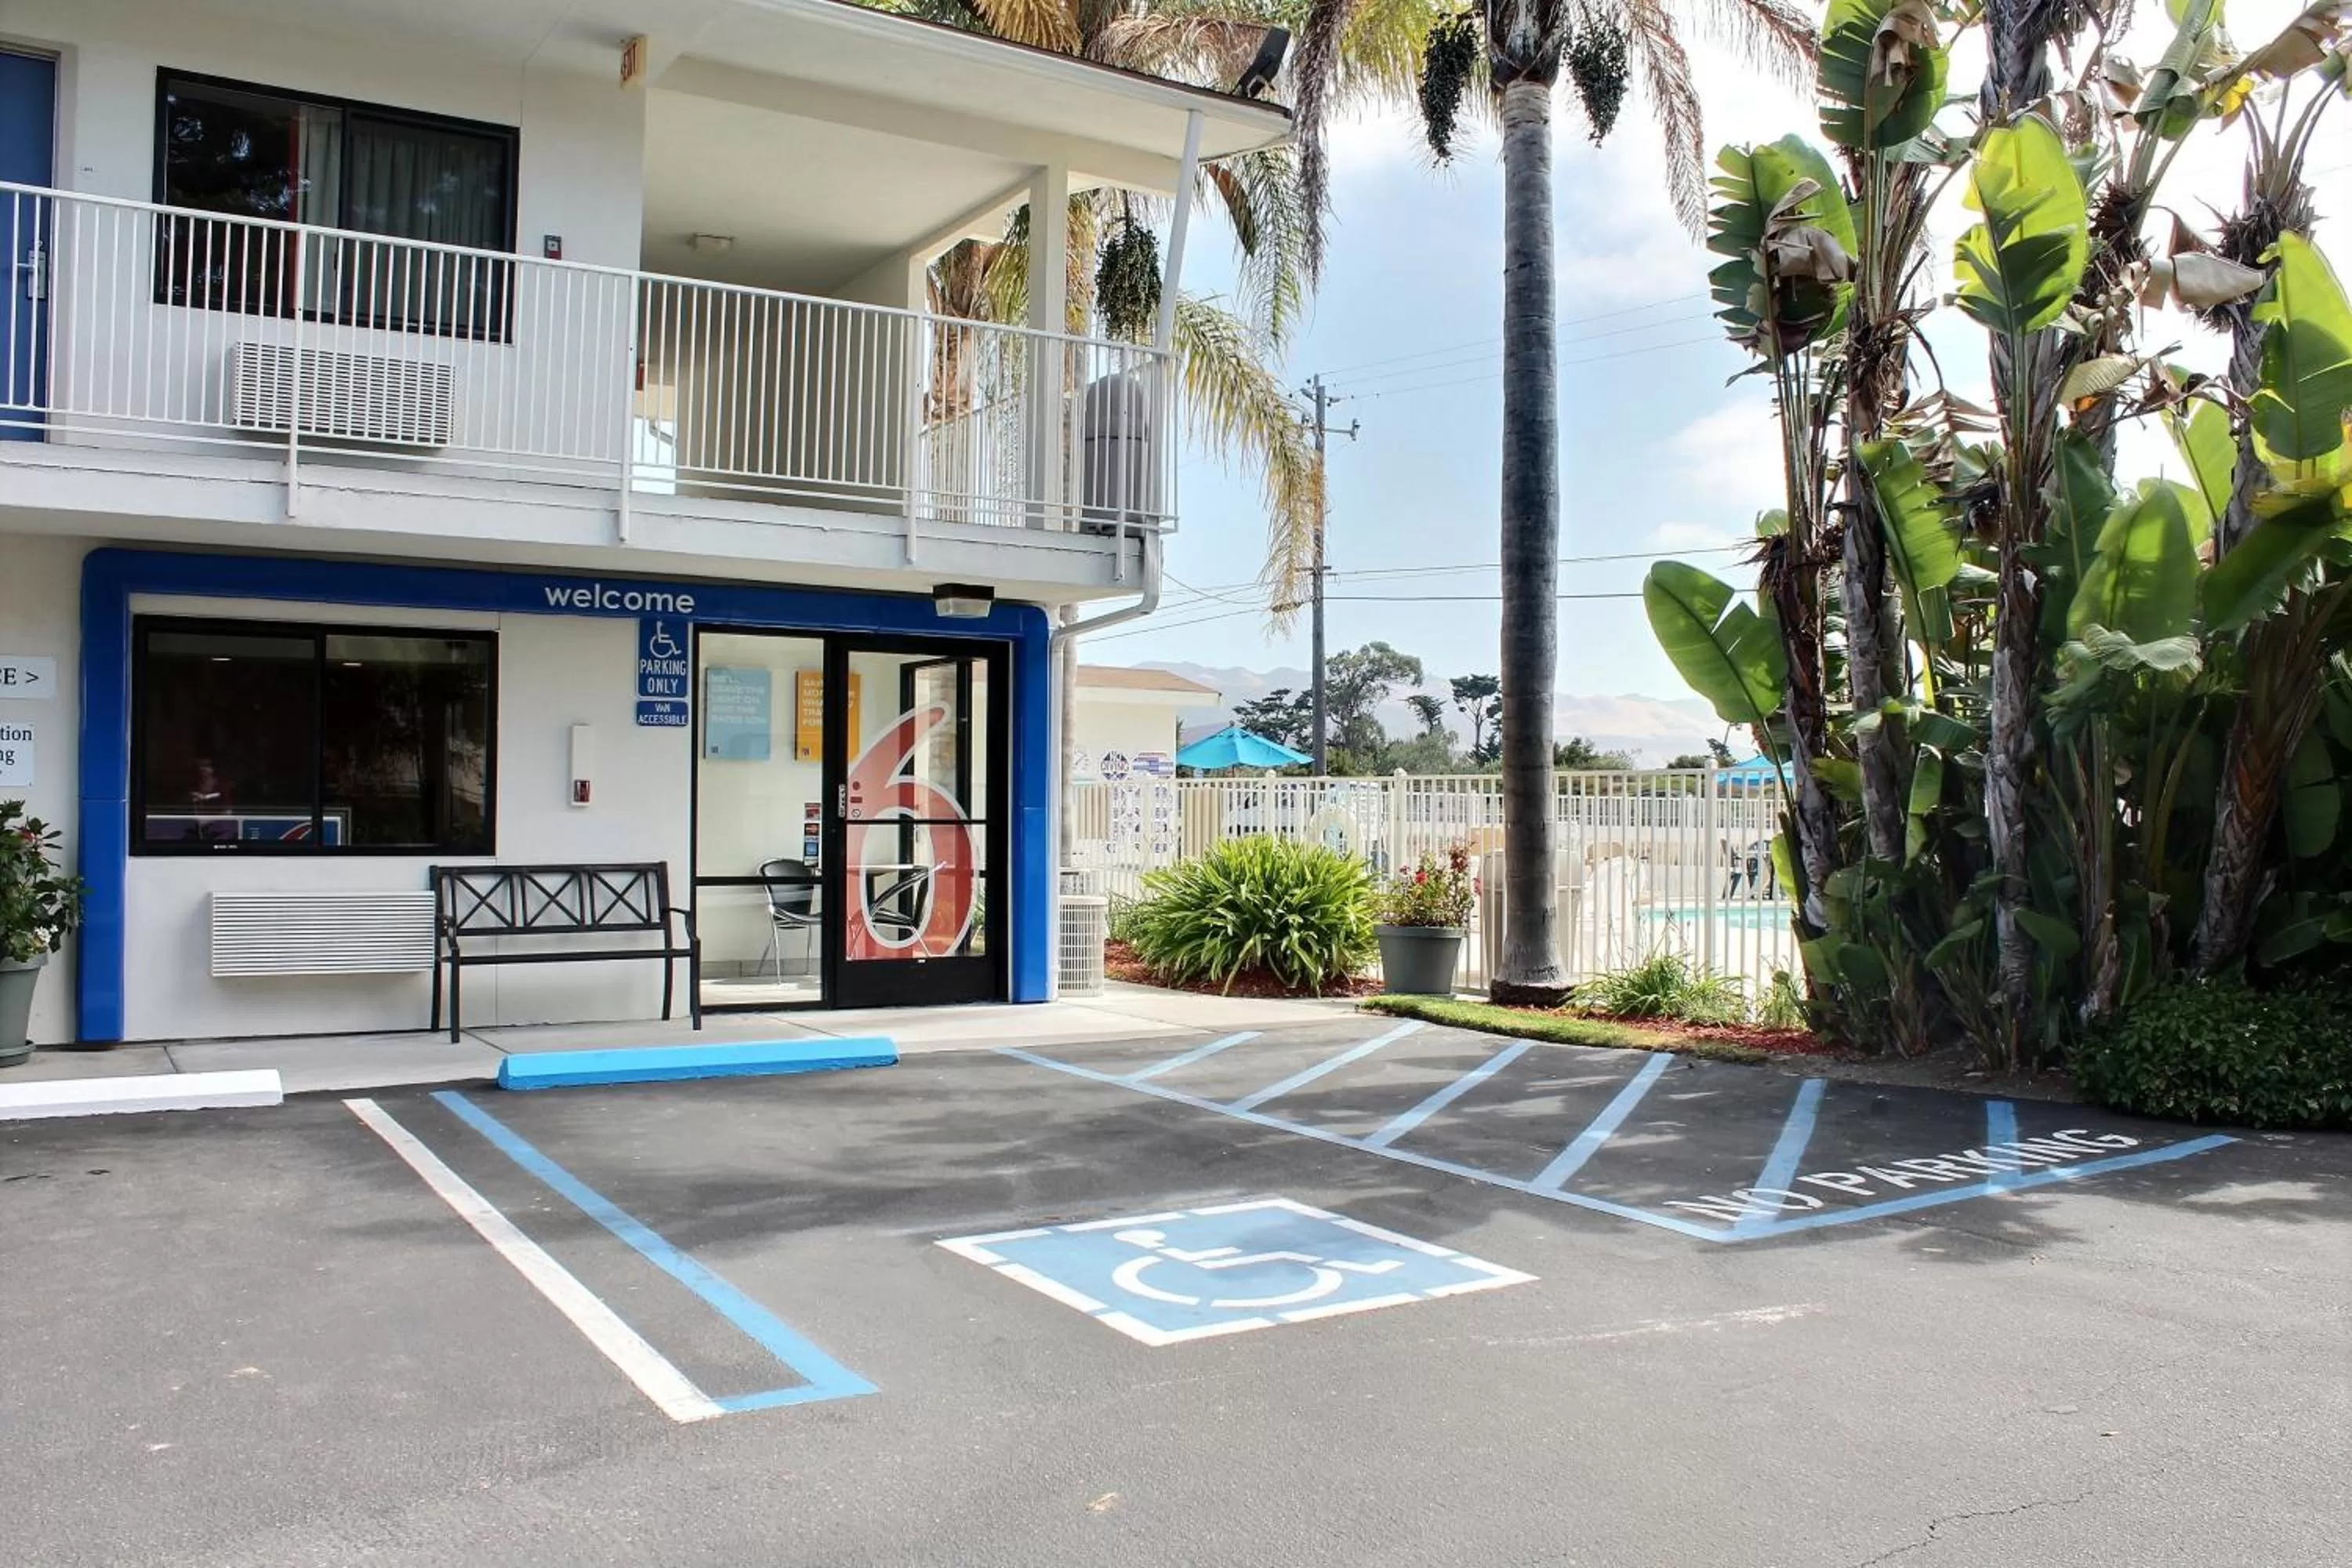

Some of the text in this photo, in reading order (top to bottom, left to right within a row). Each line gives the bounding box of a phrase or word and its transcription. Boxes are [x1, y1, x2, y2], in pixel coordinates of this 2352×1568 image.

[545, 583, 695, 613] welcome
[640, 659, 686, 676] PARKING
[647, 677, 678, 693] ONLY
[655, 703, 670, 712] VAN
[637, 715, 687, 725] ACCESSIBLE
[1662, 1129, 2139, 1221] NO PARKING
